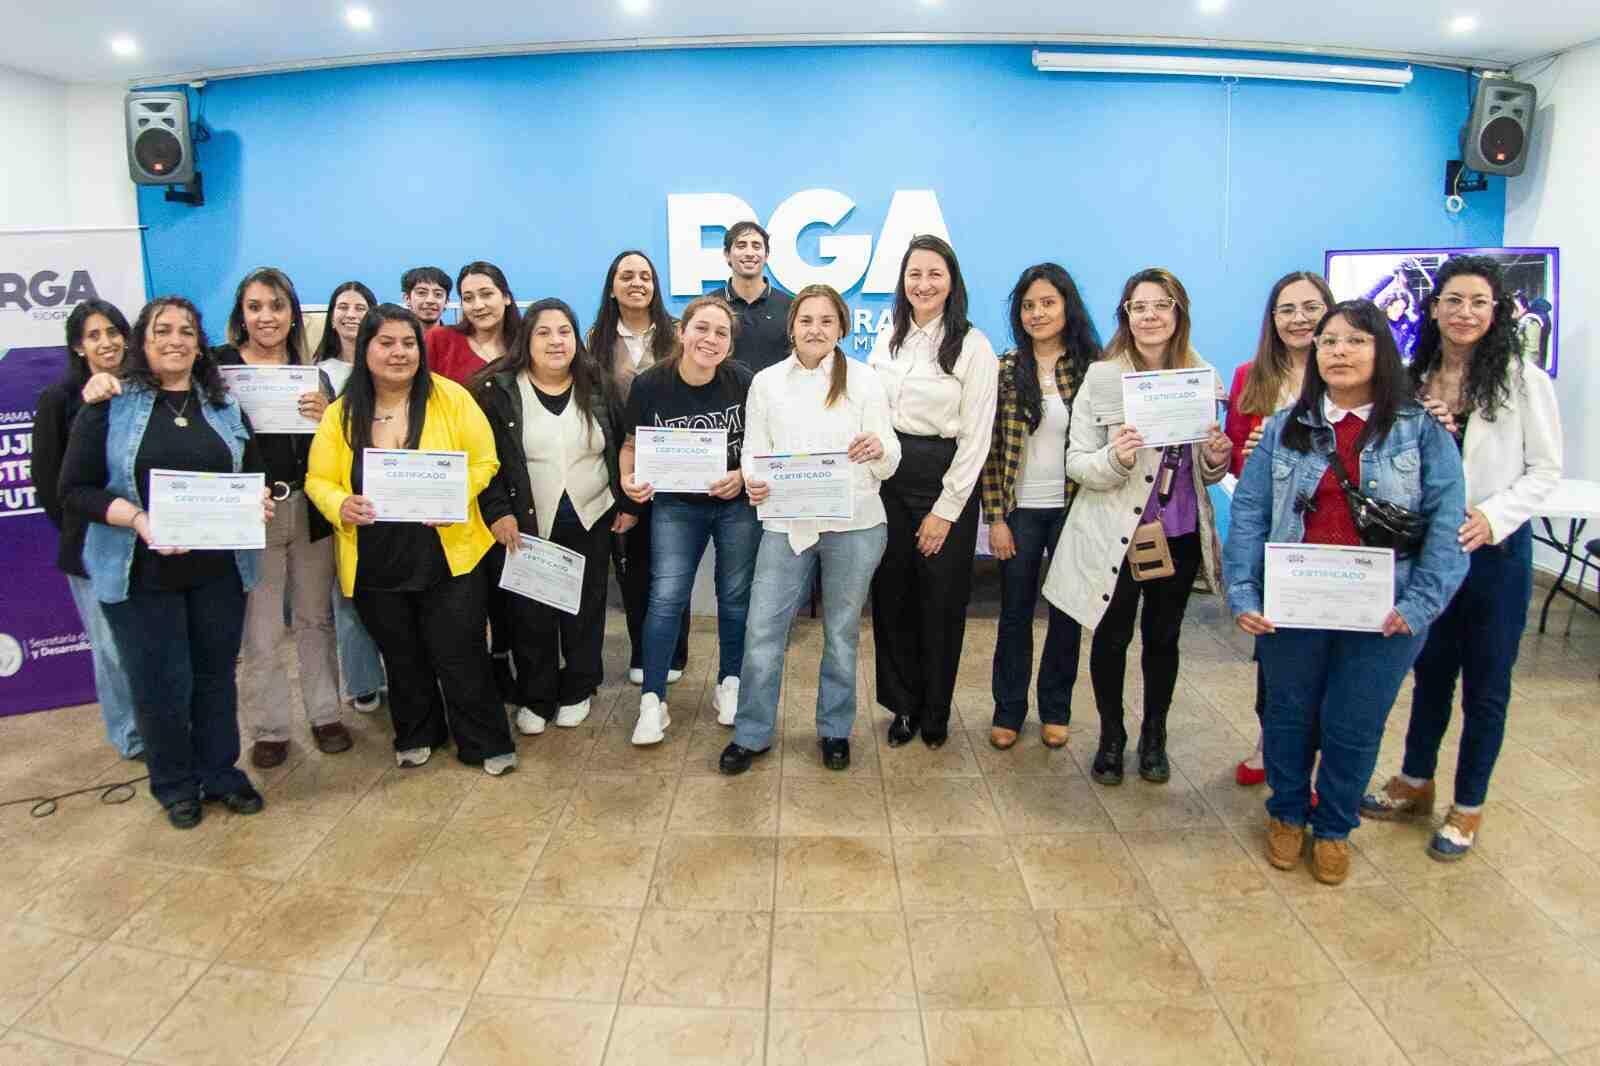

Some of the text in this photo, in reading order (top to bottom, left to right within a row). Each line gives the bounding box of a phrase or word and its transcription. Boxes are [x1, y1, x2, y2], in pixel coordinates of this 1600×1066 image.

[0, 270, 99, 312] RGA
[385, 471, 447, 480] CERTIFICADO
[773, 471, 832, 480] CERTIFICADO
[1292, 567, 1366, 580] CERTIFICADO
